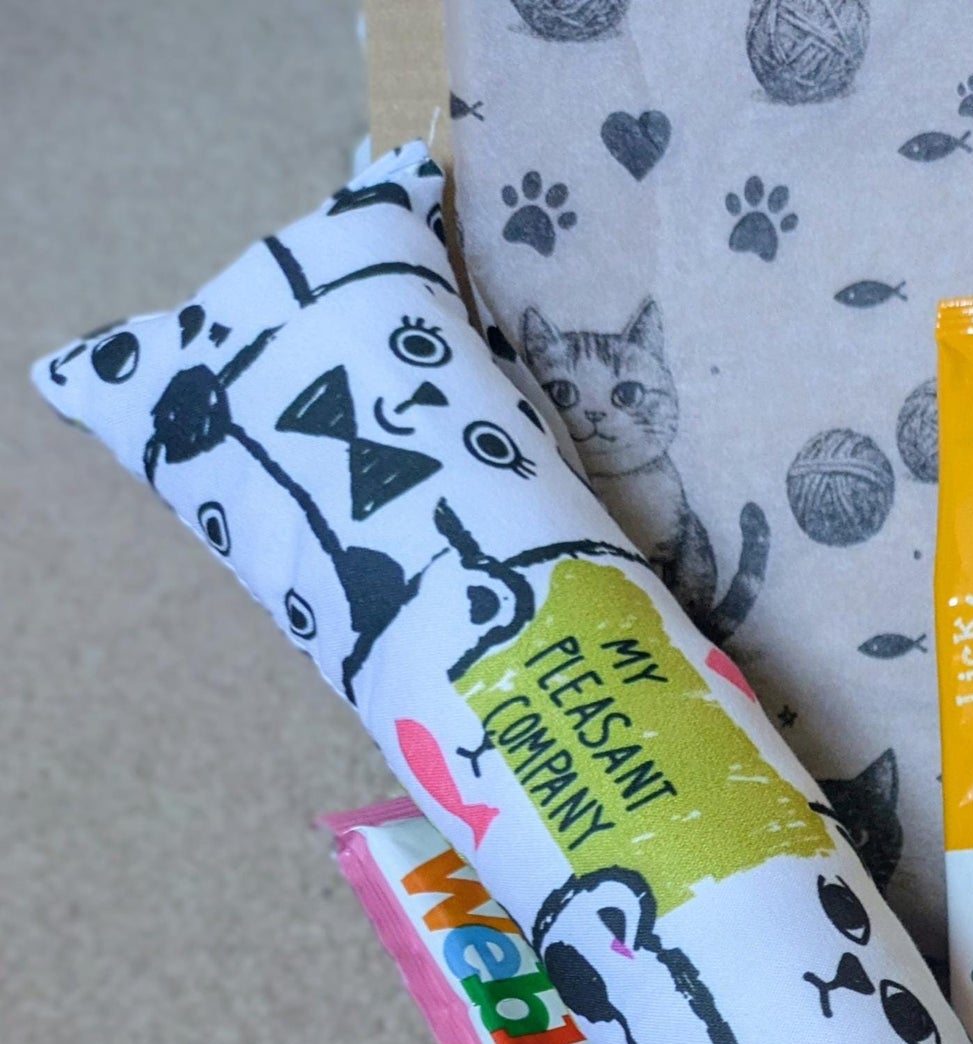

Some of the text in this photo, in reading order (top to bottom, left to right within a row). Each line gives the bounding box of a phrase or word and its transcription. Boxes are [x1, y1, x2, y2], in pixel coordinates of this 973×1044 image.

[525, 636, 677, 812] PLEASANT
[601, 639, 668, 684] MY
[483, 695, 616, 851] COMPANY
